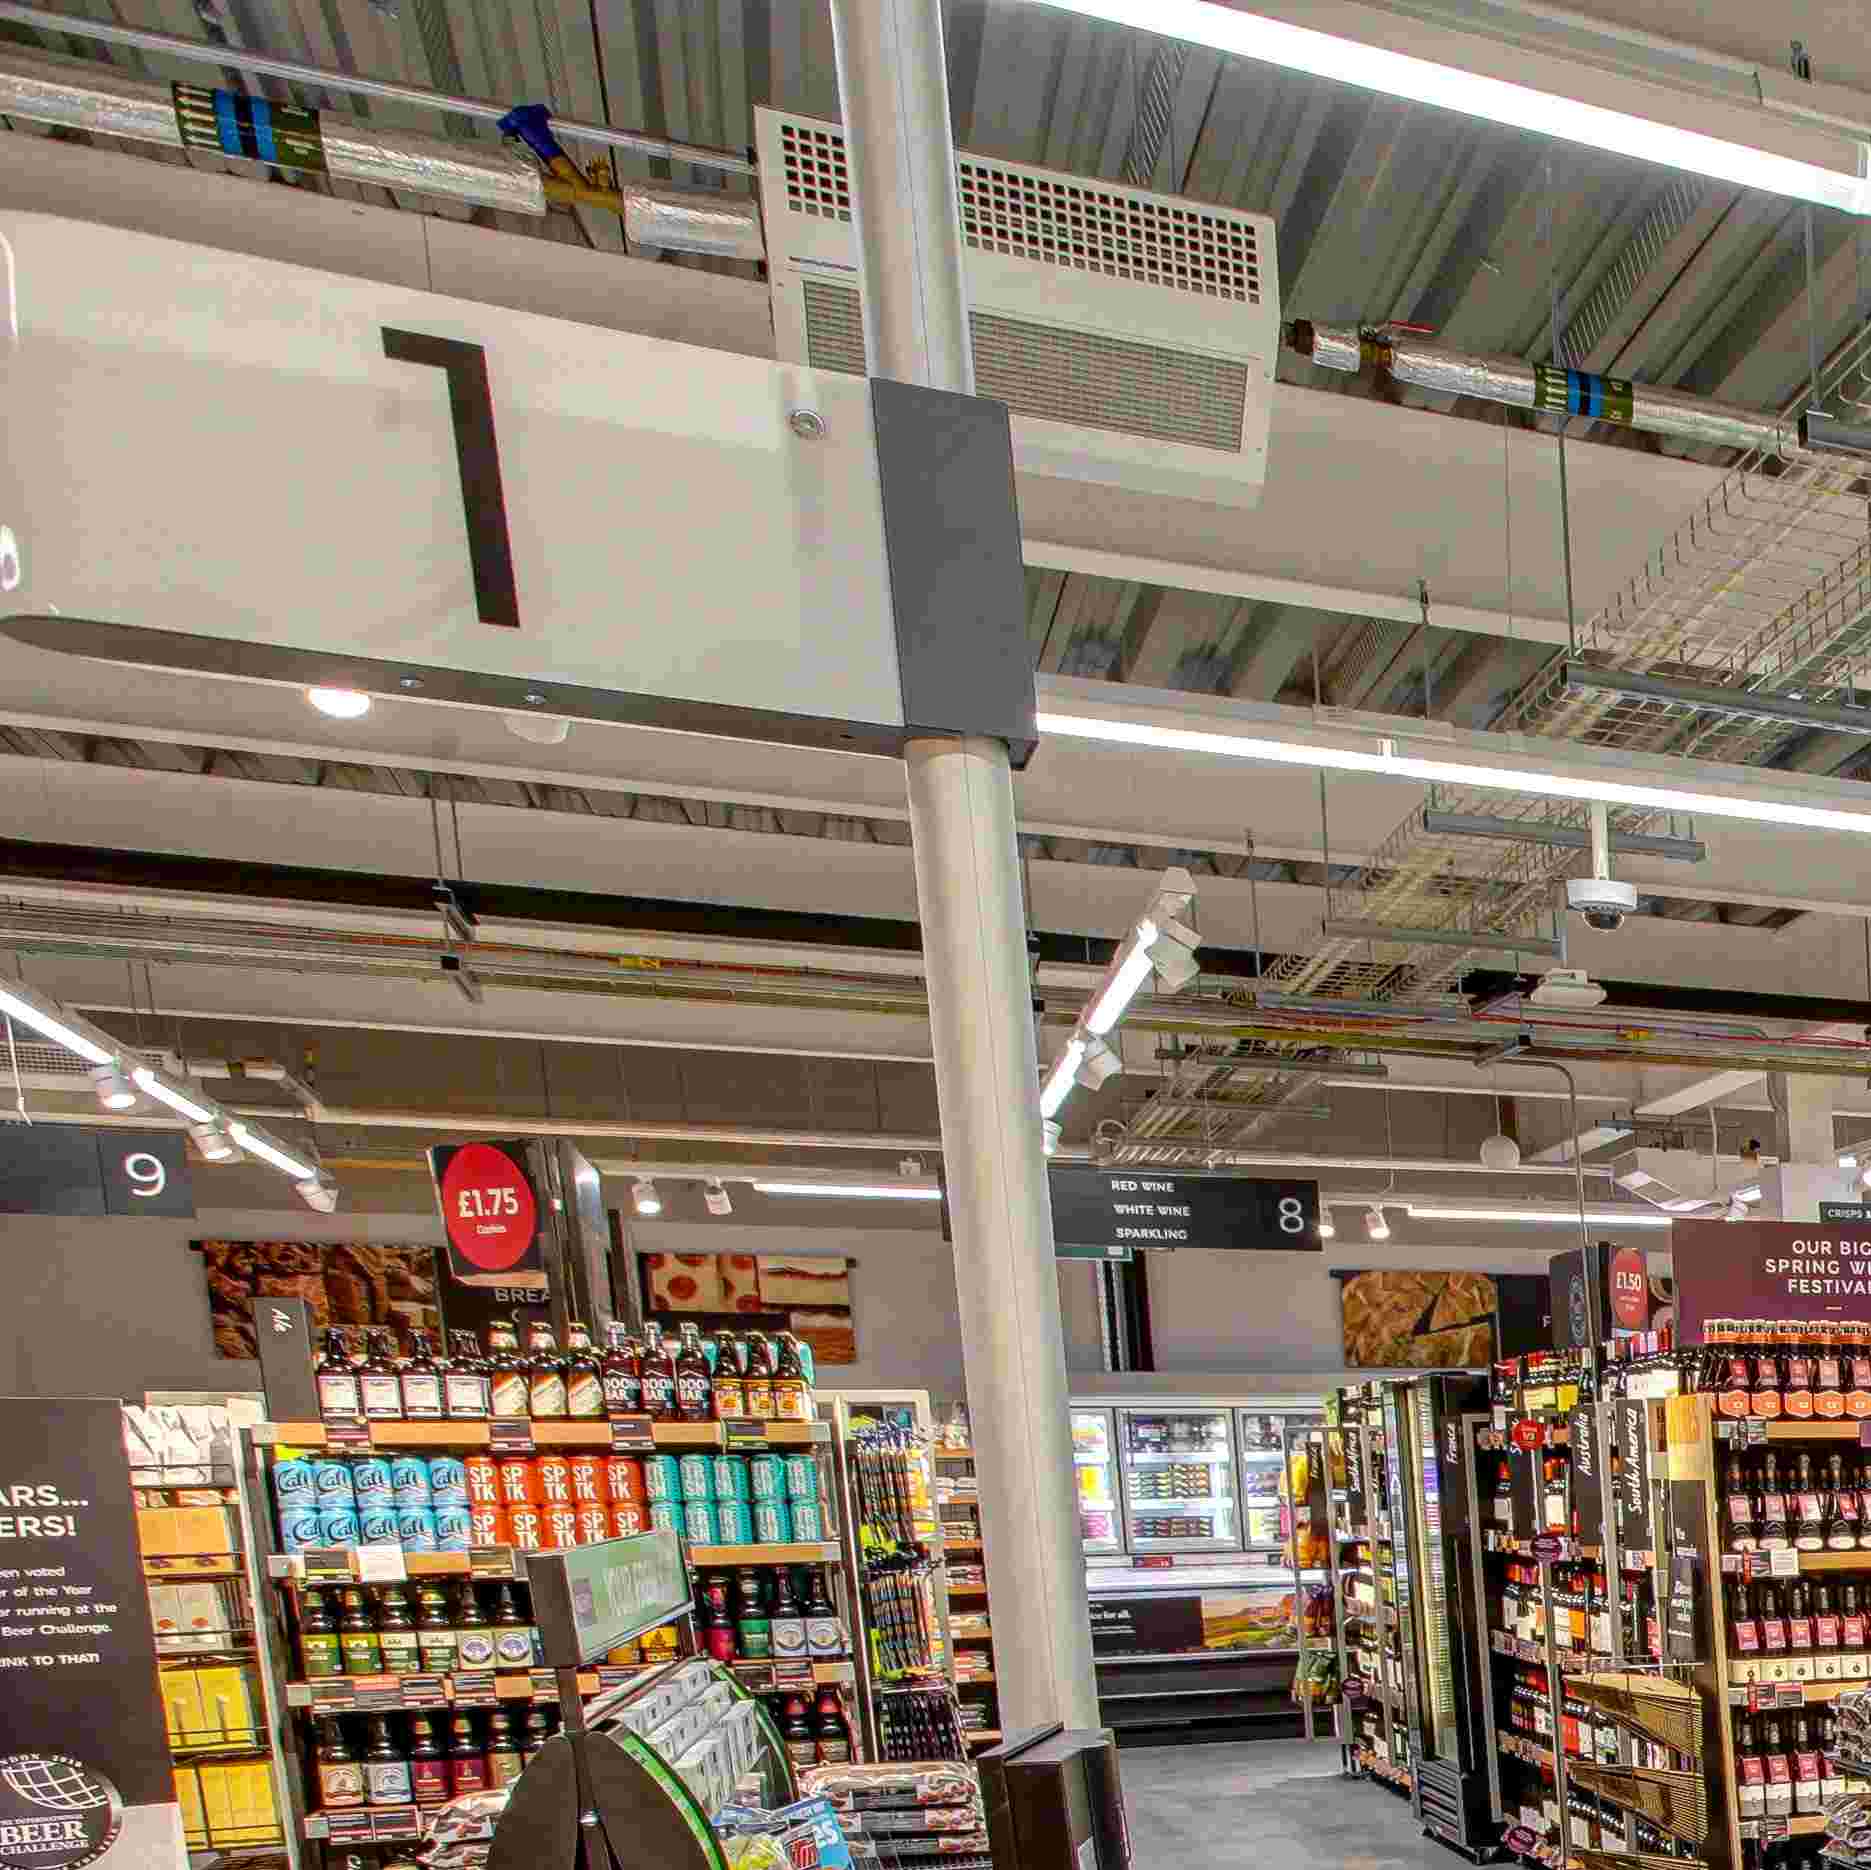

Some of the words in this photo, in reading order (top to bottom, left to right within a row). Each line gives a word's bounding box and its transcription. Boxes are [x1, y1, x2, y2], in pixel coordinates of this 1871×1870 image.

[380, 326, 520, 628] 1
[124, 1152, 167, 1197] 9
[1111, 1180, 1137, 1192] RED
[1142, 1182, 1175, 1193] WINE
[458, 1187, 519, 1217] £1.75
[1114, 1204, 1153, 1216] WHITE
[1157, 1205, 1192, 1217] WINE
[1278, 1197, 1304, 1233] 8
[1827, 1208, 1863, 1218] CRISPS
[1115, 1227, 1188, 1240] SPARKLING
[1792, 1240, 1832, 1255] OUR
[1765, 1258, 1840, 1275] SPRING
[1445, 1423, 1458, 1465] France
[1575, 1413, 1592, 1476] Australia
[1624, 1408, 1640, 1468] America
[469, 1466, 493, 1484] SP
[501, 1466, 523, 1483] SP
[543, 1466, 565, 1483] SP
[573, 1467, 593, 1482] SP
[607, 1464, 628, 1482] SP
[471, 1483, 496, 1500] TK
[504, 1484, 527, 1500] TK
[544, 1483, 568, 1500] TK
[575, 1483, 596, 1499] TK
[609, 1482, 631, 1498] TK
[1625, 1471, 1642, 1514] South
[473, 1514, 494, 1531] SP
[513, 1513, 536, 1530] SP
[551, 1513, 575, 1530] SP
[582, 1512, 604, 1529] SP
[616, 1511, 639, 1529] SP
[25, 1567, 66, 1578] voted
[13, 1586, 28, 1597] of
[33, 1585, 58, 1597] the
[61, 1584, 93, 1596] Year
[16, 1604, 71, 1618] running
[75, 1603, 90, 1615] at
[94, 1602, 118, 1614] the
[1, 1625, 34, 1637] Beer
[39, 1623, 112, 1636] Challenge.
[33, 1654, 55, 1666] TO
[57, 1652, 100, 1665] THAT!
[0, 1820, 88, 1845] BEER
[0, 1839, 90, 1856] CHALLENGE
